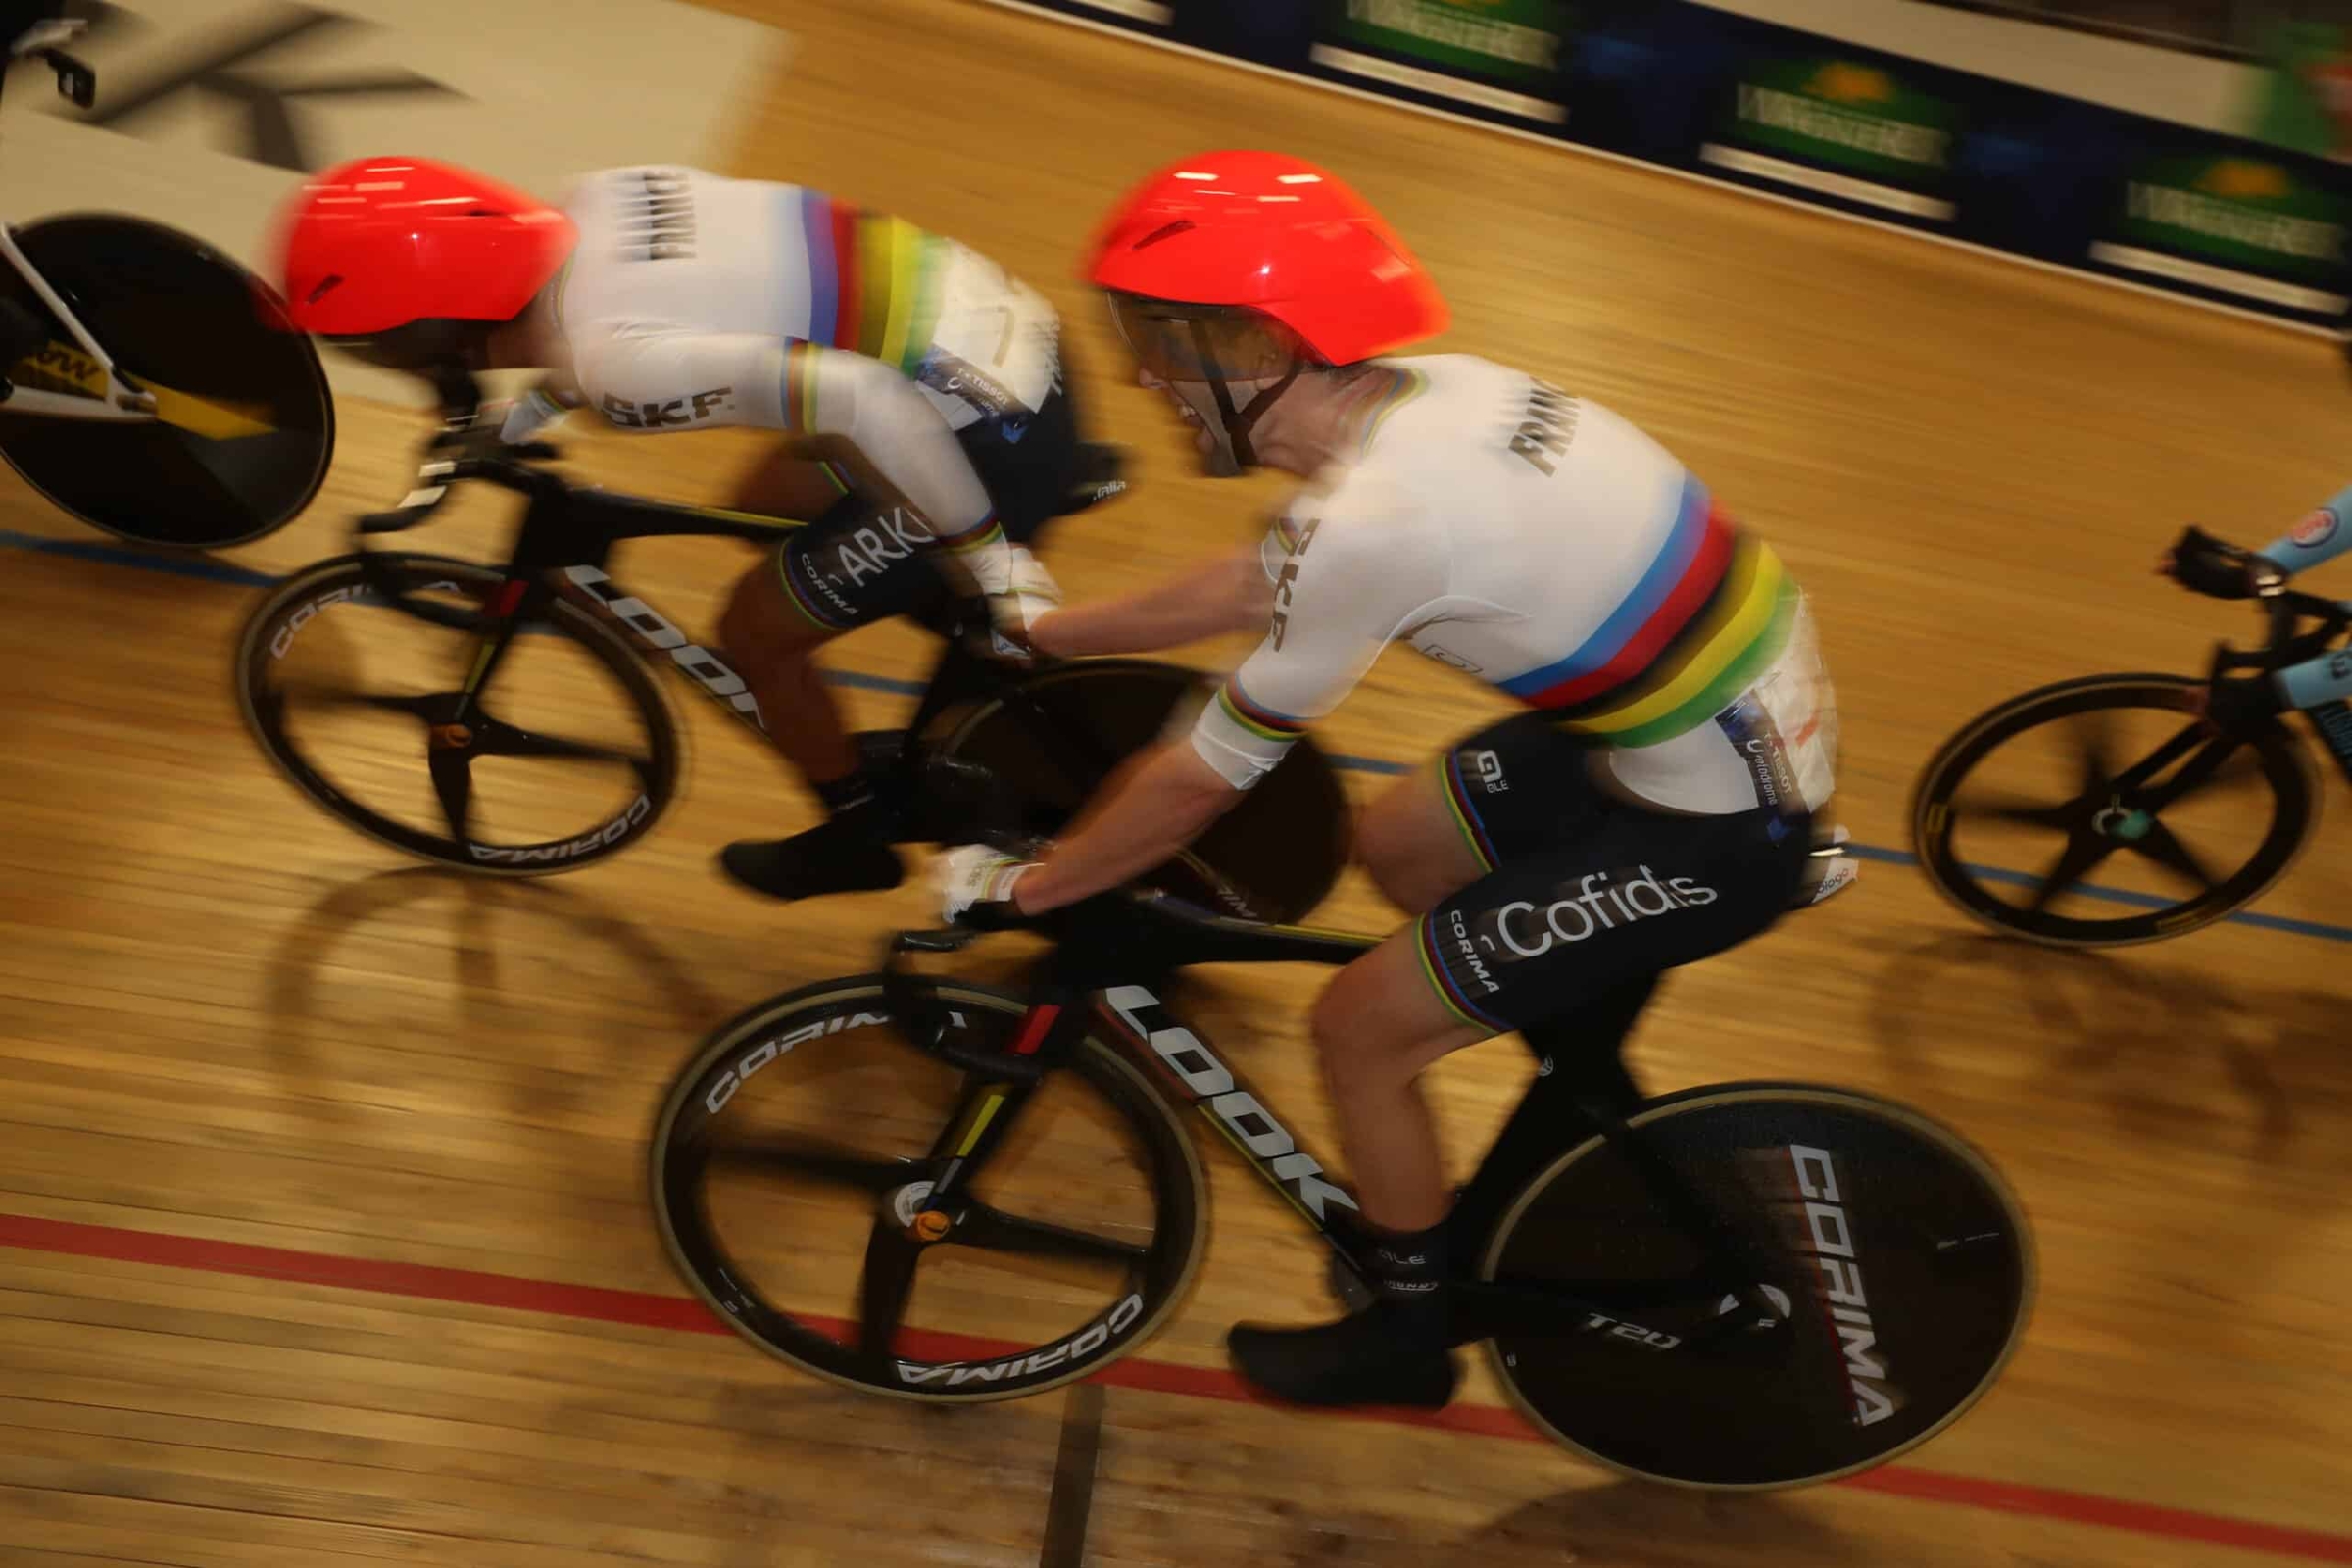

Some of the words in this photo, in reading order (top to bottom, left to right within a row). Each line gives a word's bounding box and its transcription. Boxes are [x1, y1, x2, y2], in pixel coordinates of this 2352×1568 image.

[603, 387, 732, 427] SKF
[801, 553, 860, 615] CORIMA
[839, 506, 936, 588] ARK
[470, 794, 651, 863] CORIMA
[1450, 909, 1500, 994] CORIMA
[1105, 984, 1361, 1222] LOOK
[1788, 1143, 1896, 1428] CORIMA
[896, 1293, 1144, 1386] CORIMA
